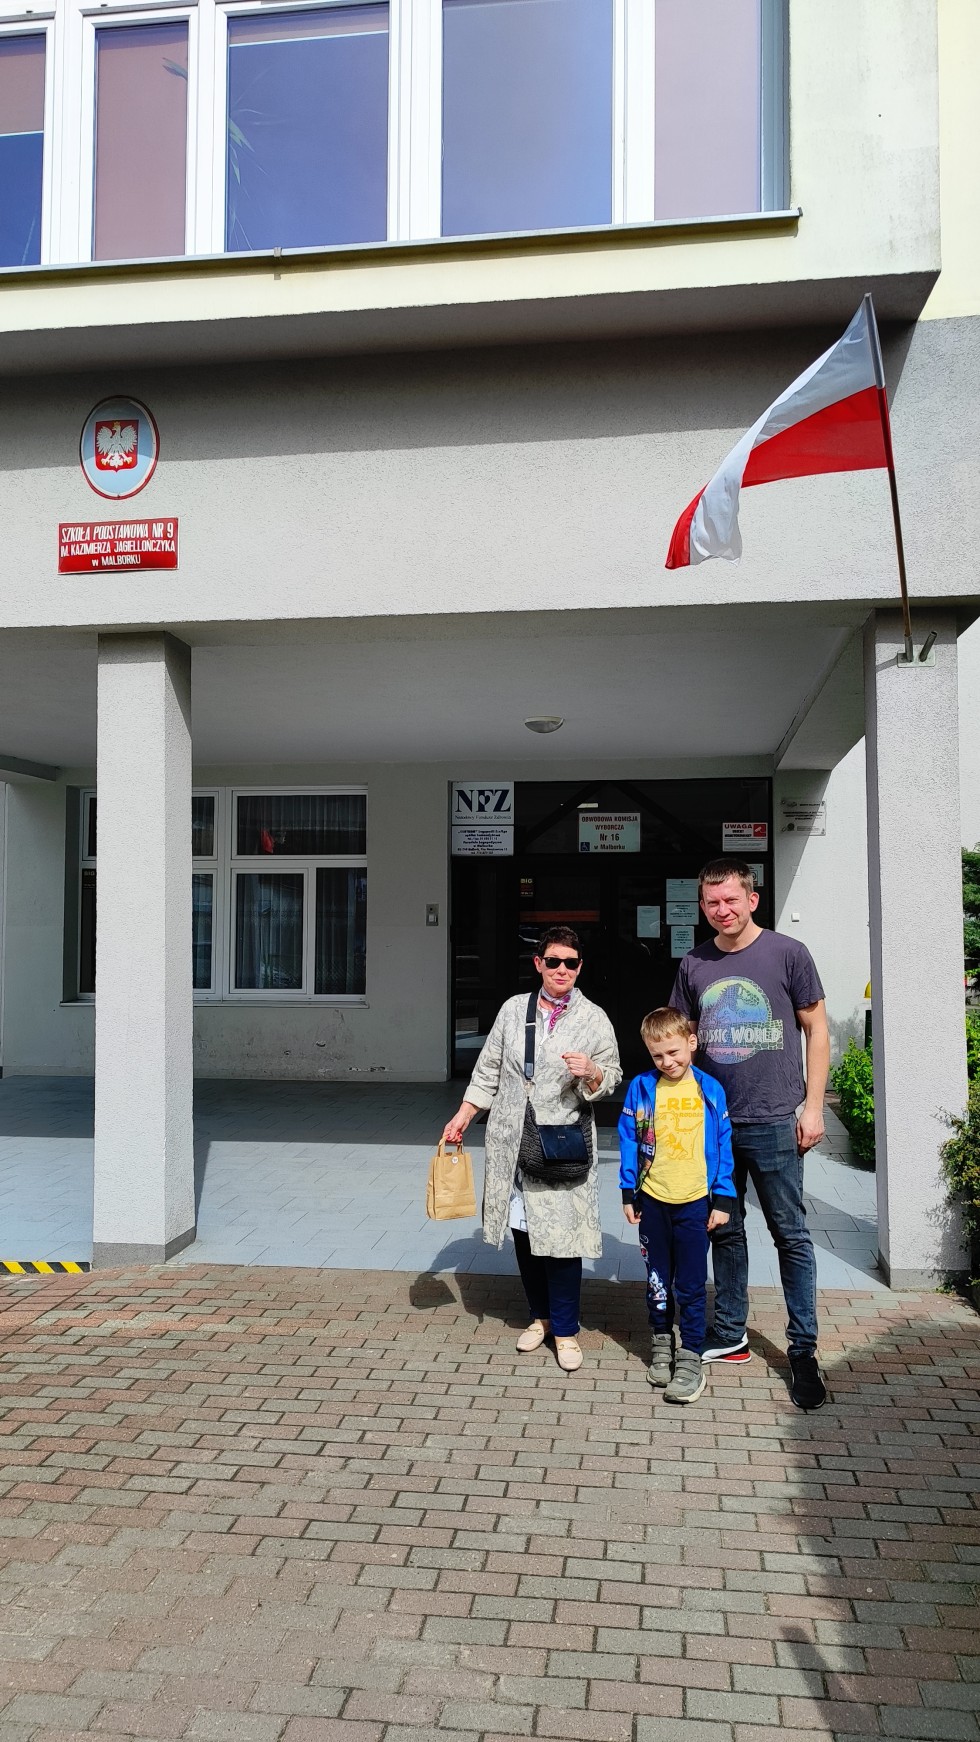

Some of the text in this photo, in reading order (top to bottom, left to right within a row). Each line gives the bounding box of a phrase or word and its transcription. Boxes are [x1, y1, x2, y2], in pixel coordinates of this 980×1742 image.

[62, 522, 174, 543] SZKOŁA PODSTAWOWA NR 9
[70, 541, 112, 556] KAZIMIERZA
[113, 538, 176, 553] JAGIELLOŃCZYKA
[91, 554, 141, 567] w MALBORKU
[454, 789, 512, 813] NFZ
[600, 833, 620, 841] Nr 16
[731, 1026, 781, 1044] WORLD
